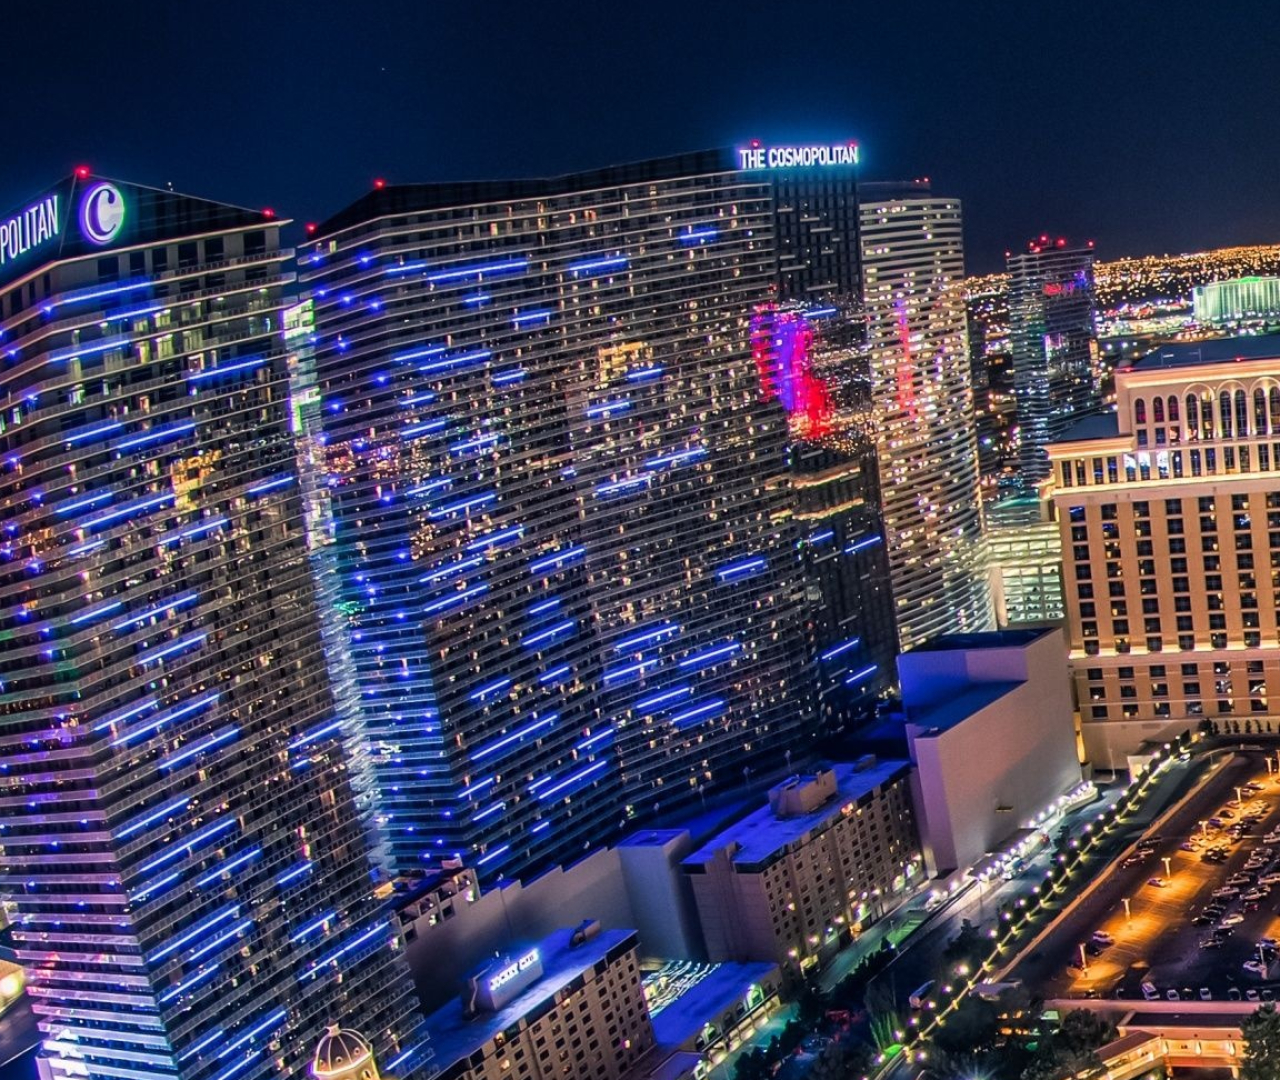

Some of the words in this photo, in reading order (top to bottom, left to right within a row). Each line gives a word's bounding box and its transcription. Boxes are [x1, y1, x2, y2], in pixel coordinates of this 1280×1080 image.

[740, 149, 766, 169] THE
[768, 146, 859, 168] COSMOPOLITAN
[0, 195, 59, 265] POLITAN
